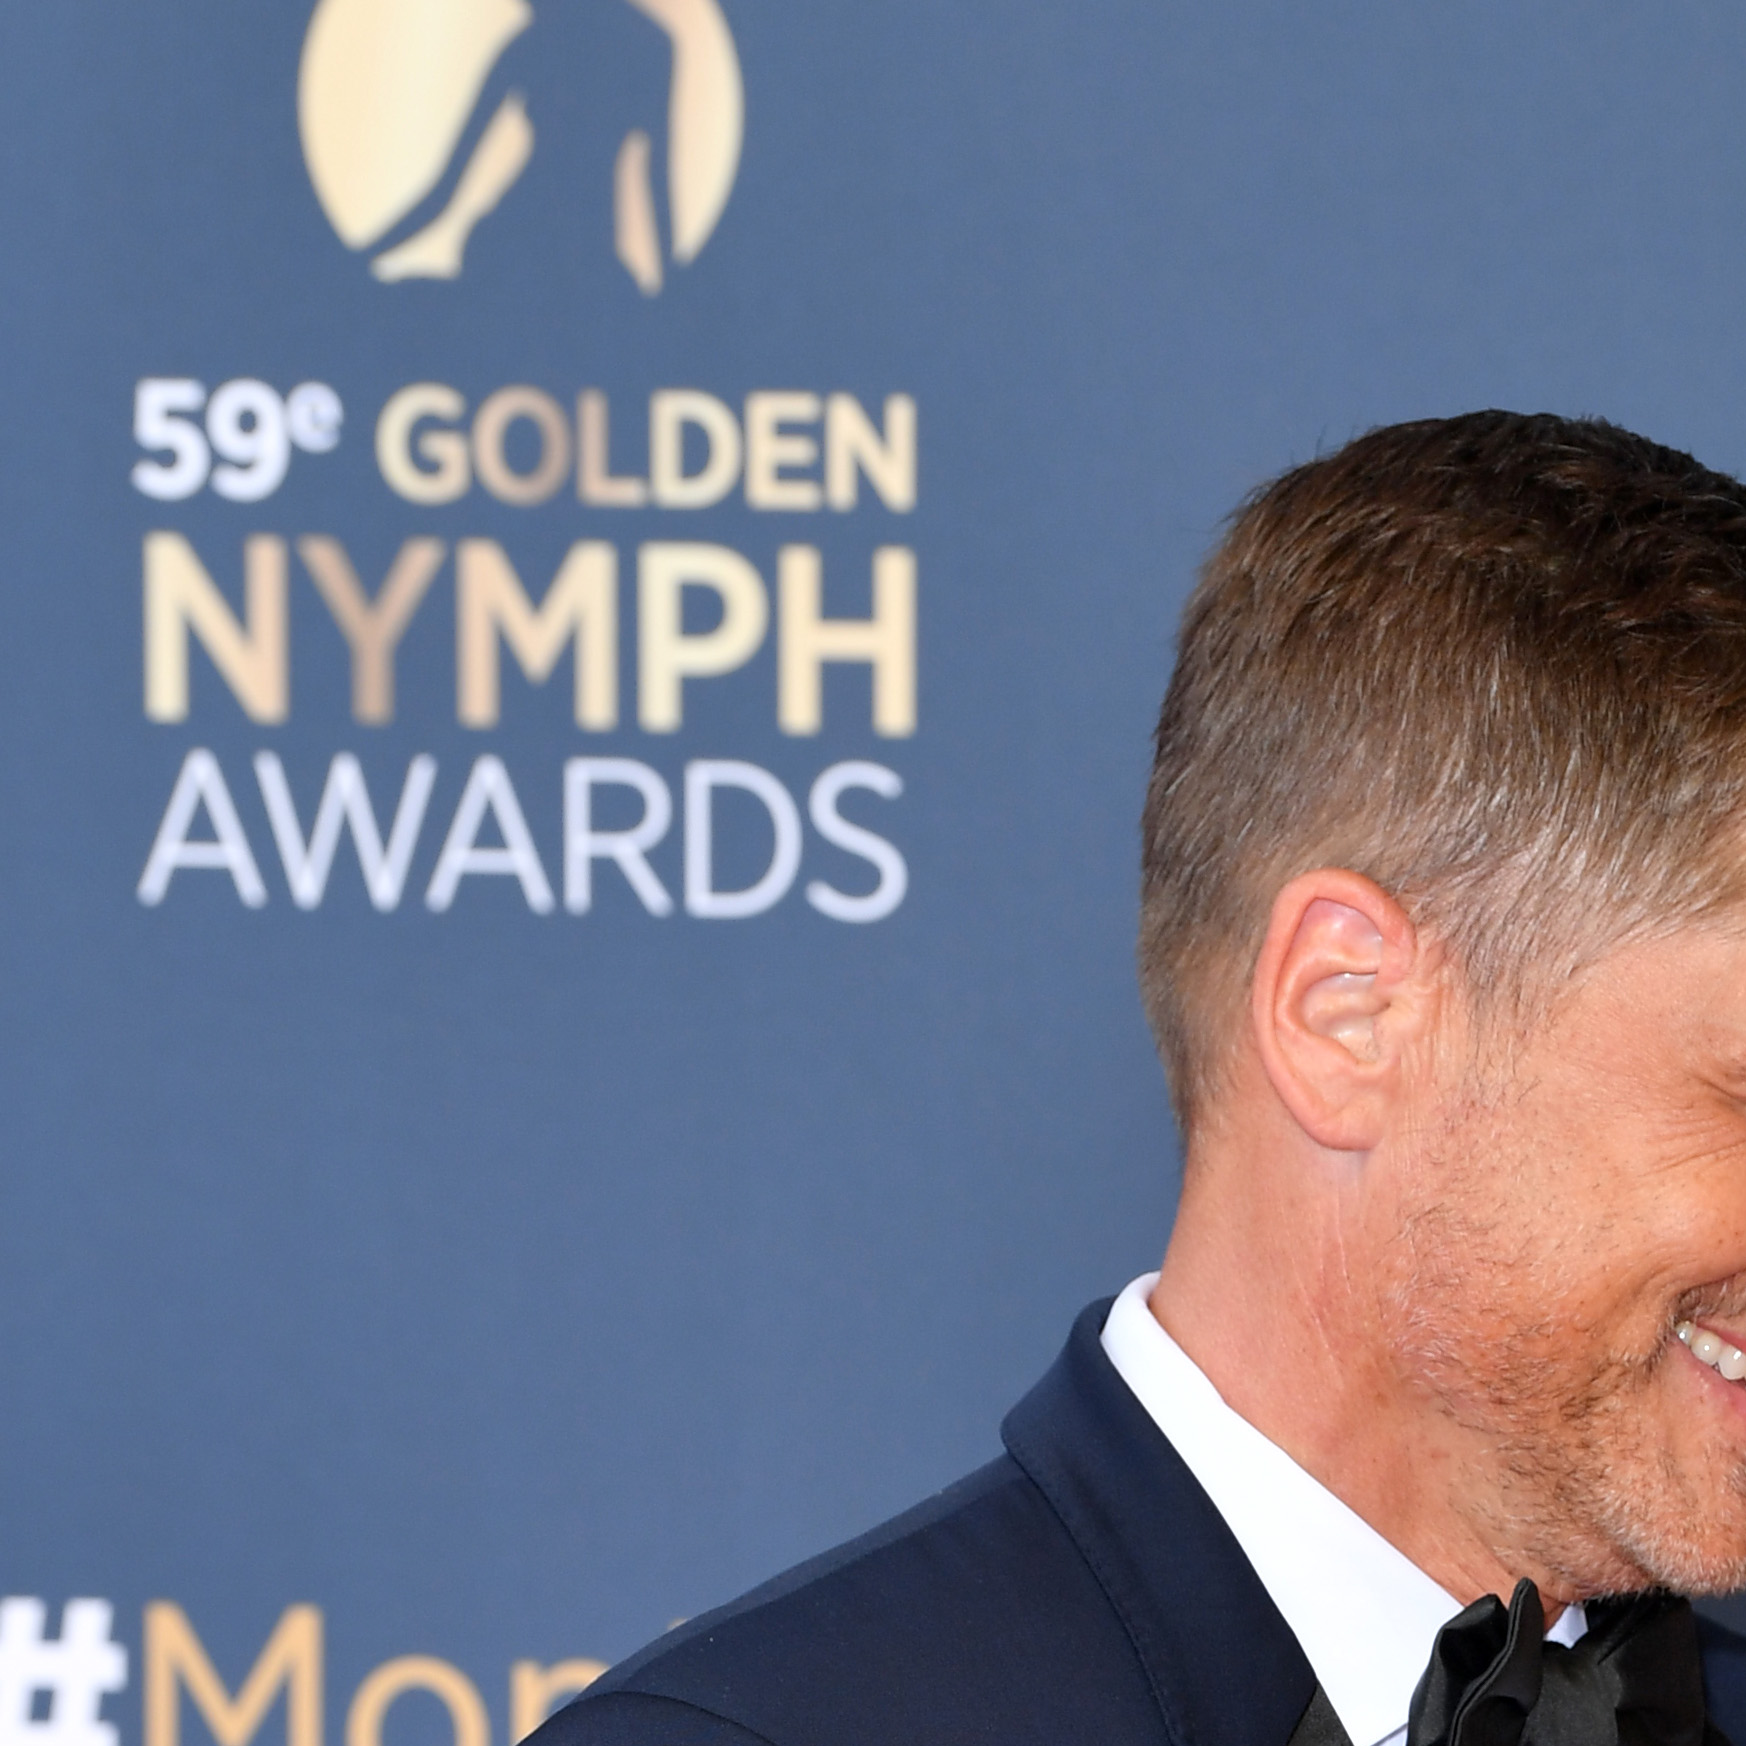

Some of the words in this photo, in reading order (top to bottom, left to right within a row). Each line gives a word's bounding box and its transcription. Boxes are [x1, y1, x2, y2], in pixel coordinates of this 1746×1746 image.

[131, 376, 344, 501] 59e
[374, 383, 917, 512] GOLDEN
[141, 530, 918, 738] NYMPH
[137, 747, 908, 923] AWARDS
